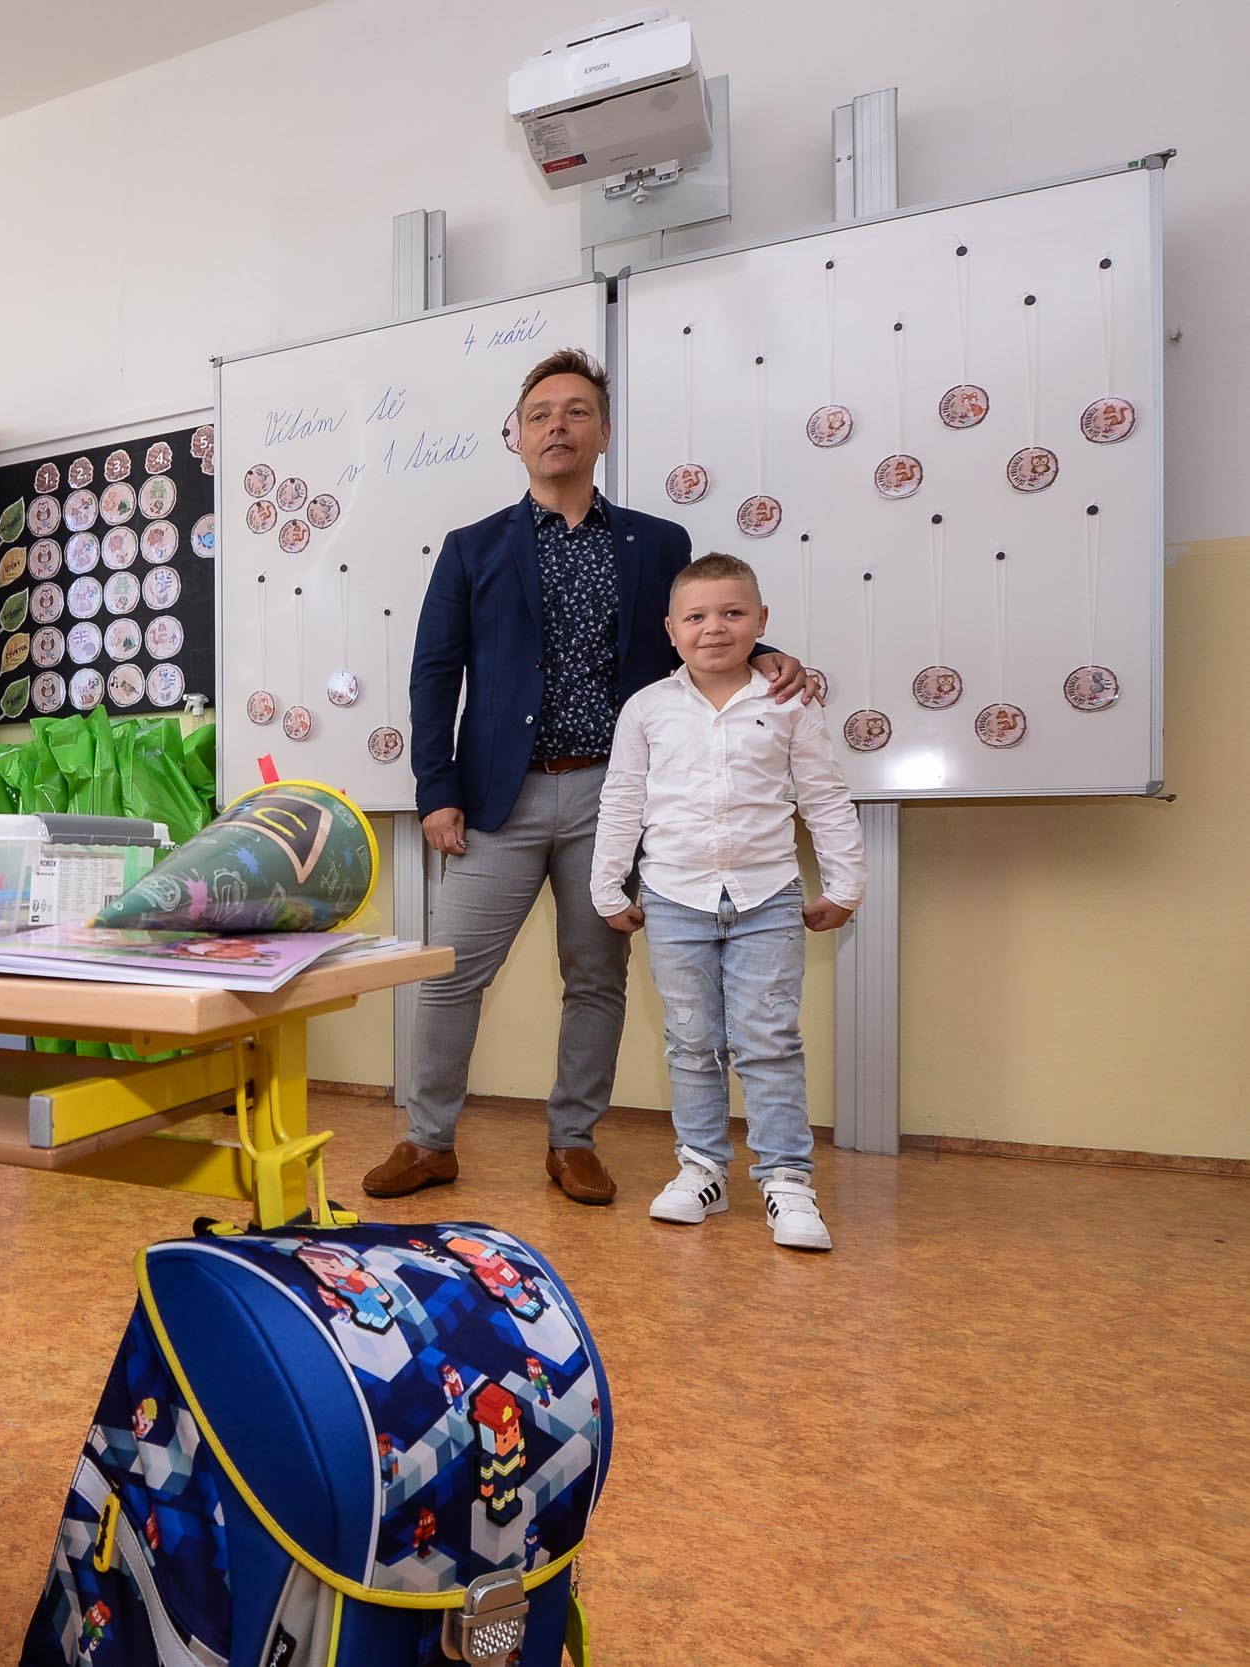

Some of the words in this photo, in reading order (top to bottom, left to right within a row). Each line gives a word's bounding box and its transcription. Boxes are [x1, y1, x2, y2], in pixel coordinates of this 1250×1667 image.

[584, 61, 610, 74] EPSON
[464, 323, 477, 356] 4
[487, 309, 547, 348] září
[265, 407, 347, 446] Vítám
[366, 386, 406, 424] tě
[337, 464, 366, 486] v
[383, 439, 395, 474] 1
[403, 430, 479, 471] třídě
[113, 460, 125, 473] 3.
[43, 473, 53, 484] 1.
[76, 467, 87, 480] 2.
